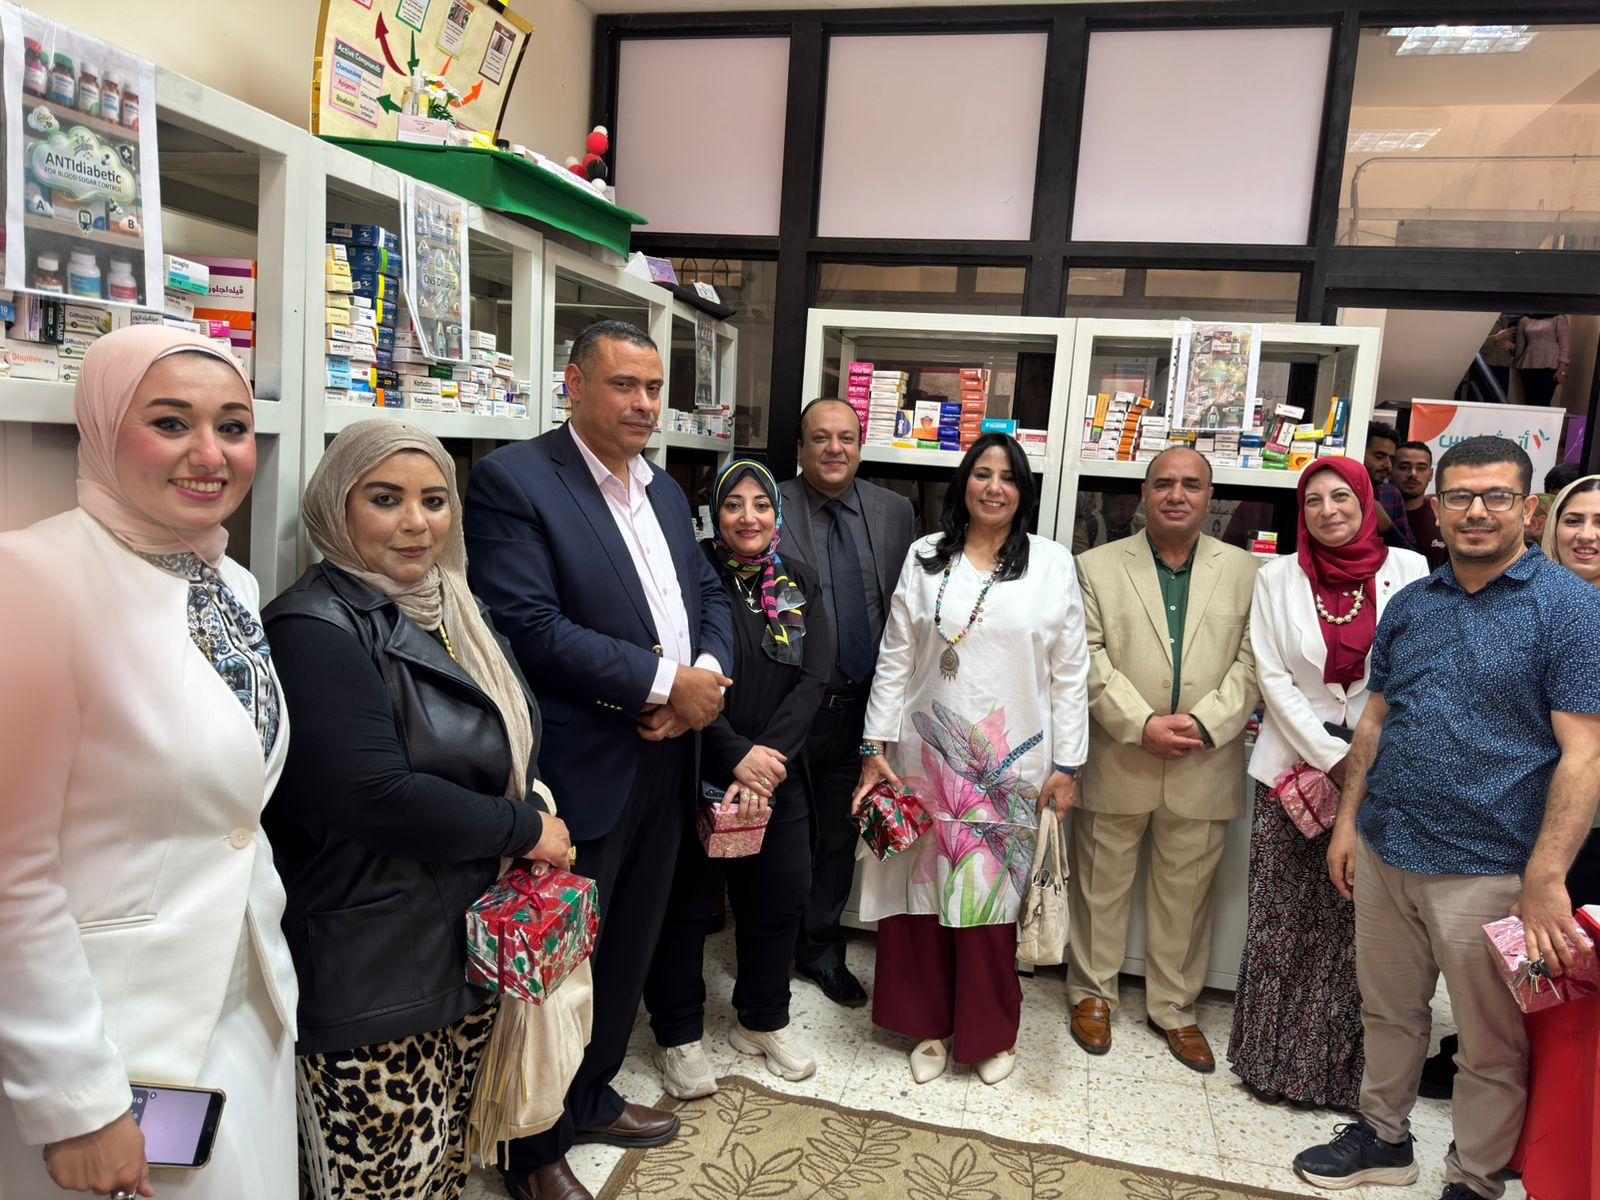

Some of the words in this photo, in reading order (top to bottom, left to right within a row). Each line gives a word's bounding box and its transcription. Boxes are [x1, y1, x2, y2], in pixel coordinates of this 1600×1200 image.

[337, 44, 355, 58] Active
[45, 152, 122, 184] ANTIdiabetic
[44, 166, 57, 176] FOR
[58, 169, 78, 181] BLOOD
[78, 174, 98, 186] SUGAR
[97, 181, 122, 193] CONTROL
[36, 200, 45, 212] A
[127, 219, 135, 229] B
[424, 274, 436, 286] CNS
